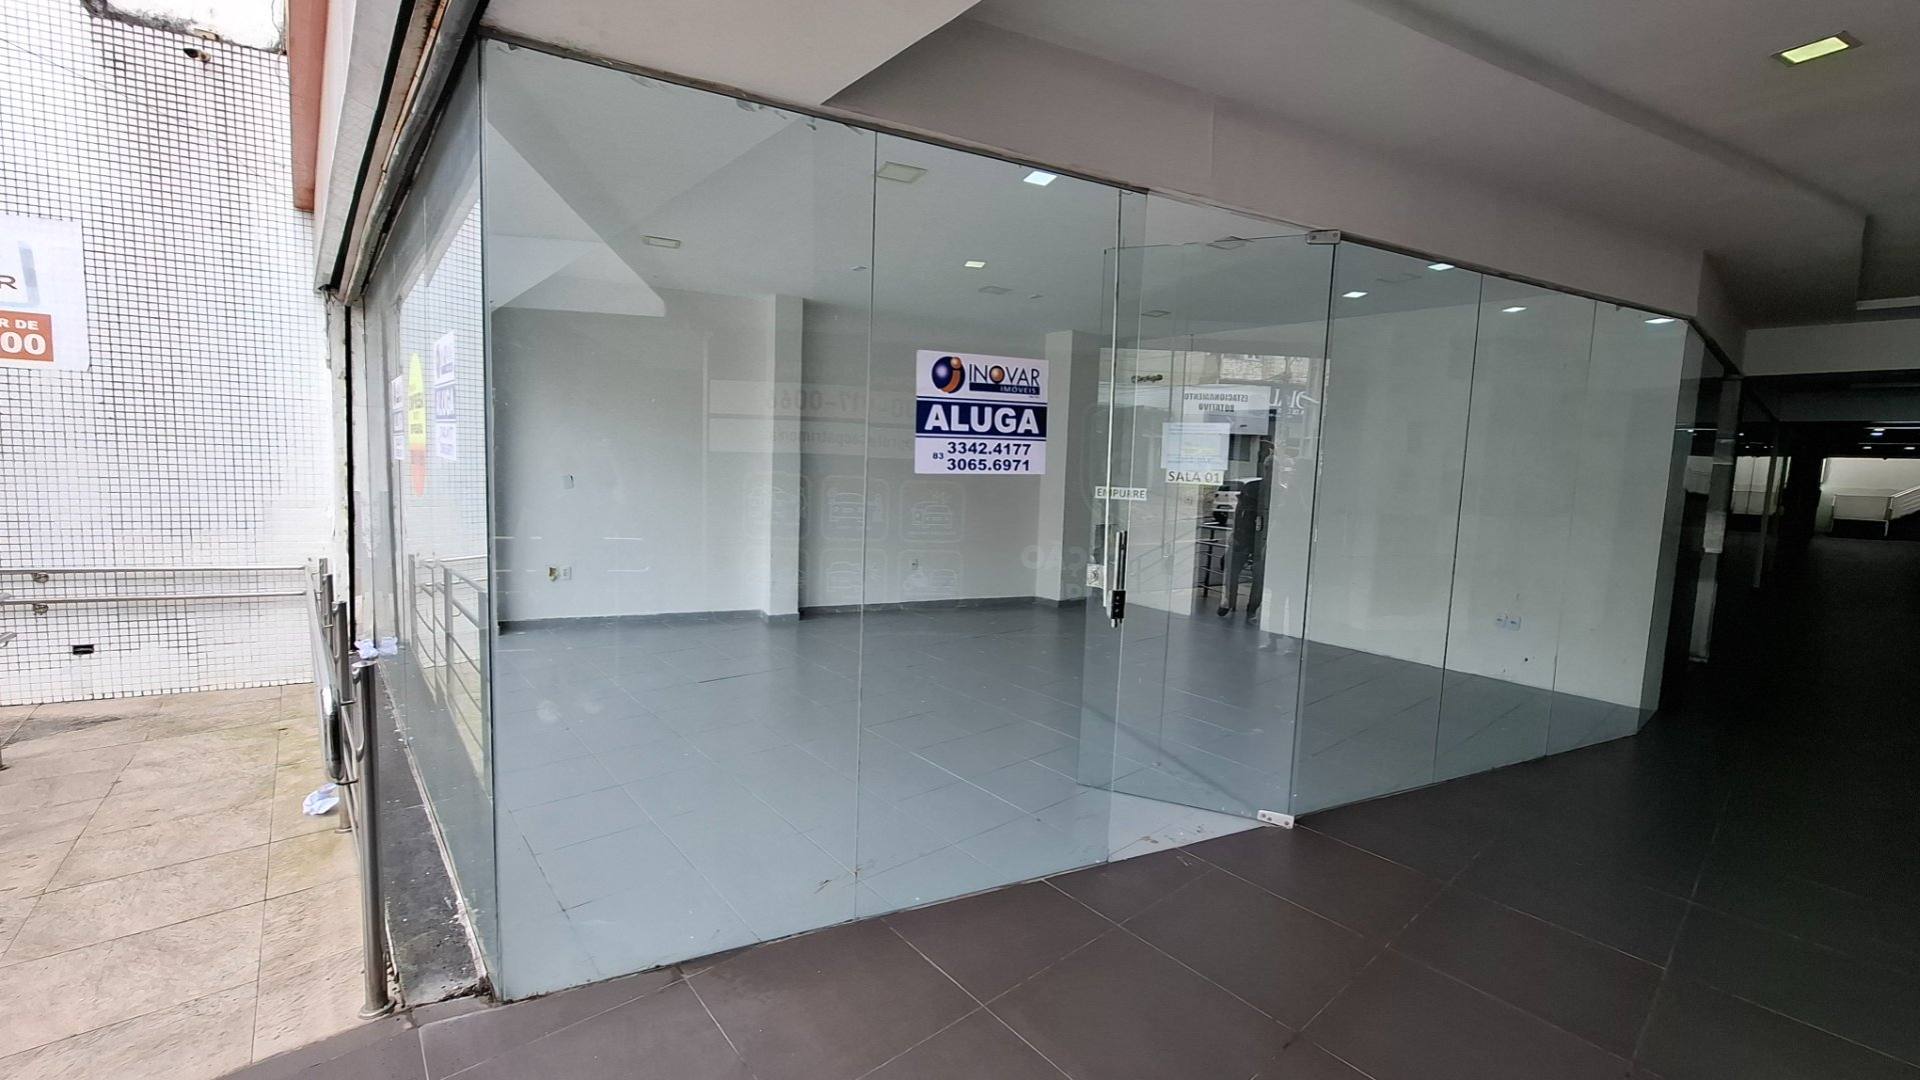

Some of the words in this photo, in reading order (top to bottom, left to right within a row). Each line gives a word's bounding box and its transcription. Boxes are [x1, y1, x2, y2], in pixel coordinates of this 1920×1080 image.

[15, 320, 39, 330] DE
[969, 364, 1040, 386] INOVAR
[924, 404, 1039, 434] ALUGA
[947, 442, 1031, 455] 3342.4177
[946, 458, 1030, 471] 3065.6971
[1168, 471, 1200, 482] SALA
[1205, 473, 1220, 483] 01
